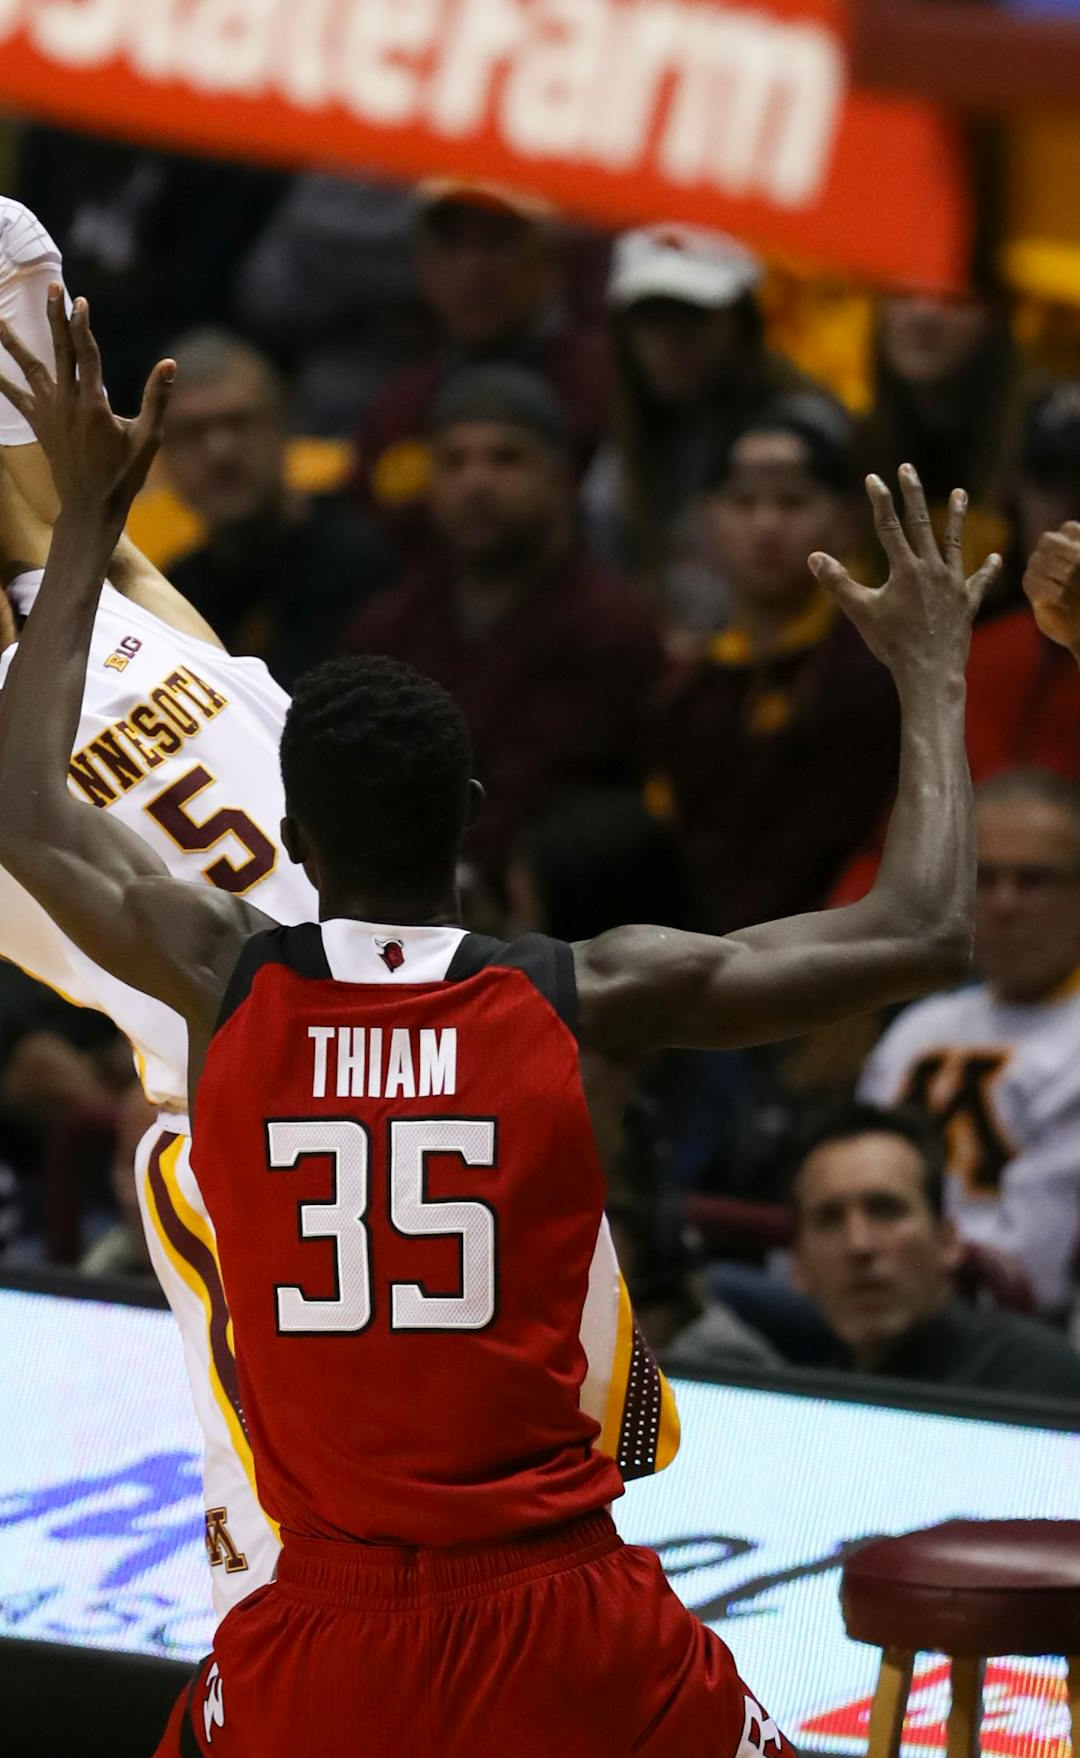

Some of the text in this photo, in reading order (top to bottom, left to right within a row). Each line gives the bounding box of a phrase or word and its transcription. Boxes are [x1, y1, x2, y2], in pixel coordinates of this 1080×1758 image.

[143, 763, 277, 896] 5
[307, 1026, 457, 1098] THIAM
[264, 1117, 498, 1334] 35
